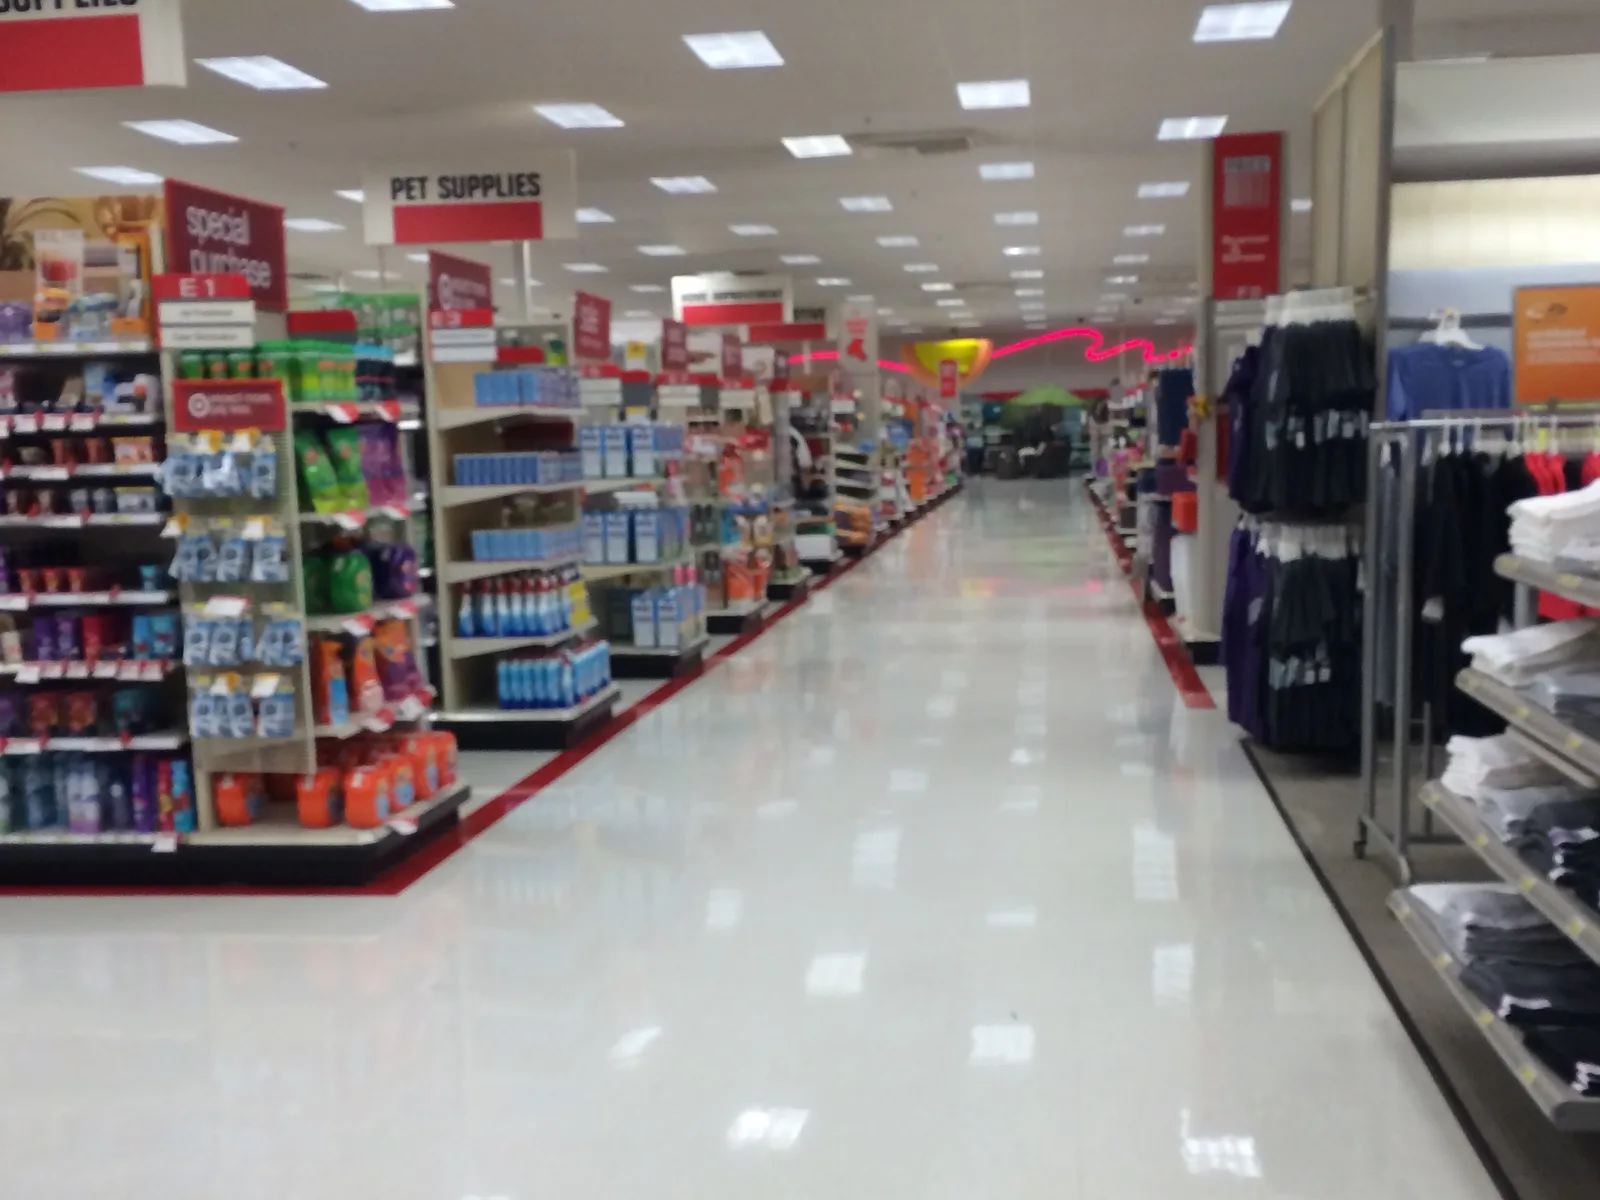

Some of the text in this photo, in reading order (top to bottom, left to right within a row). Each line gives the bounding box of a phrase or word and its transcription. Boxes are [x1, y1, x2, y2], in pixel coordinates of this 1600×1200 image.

[391, 172, 541, 200] PET SUPPLIES
[186, 205, 249, 245] special
[180, 278, 197, 297] E
